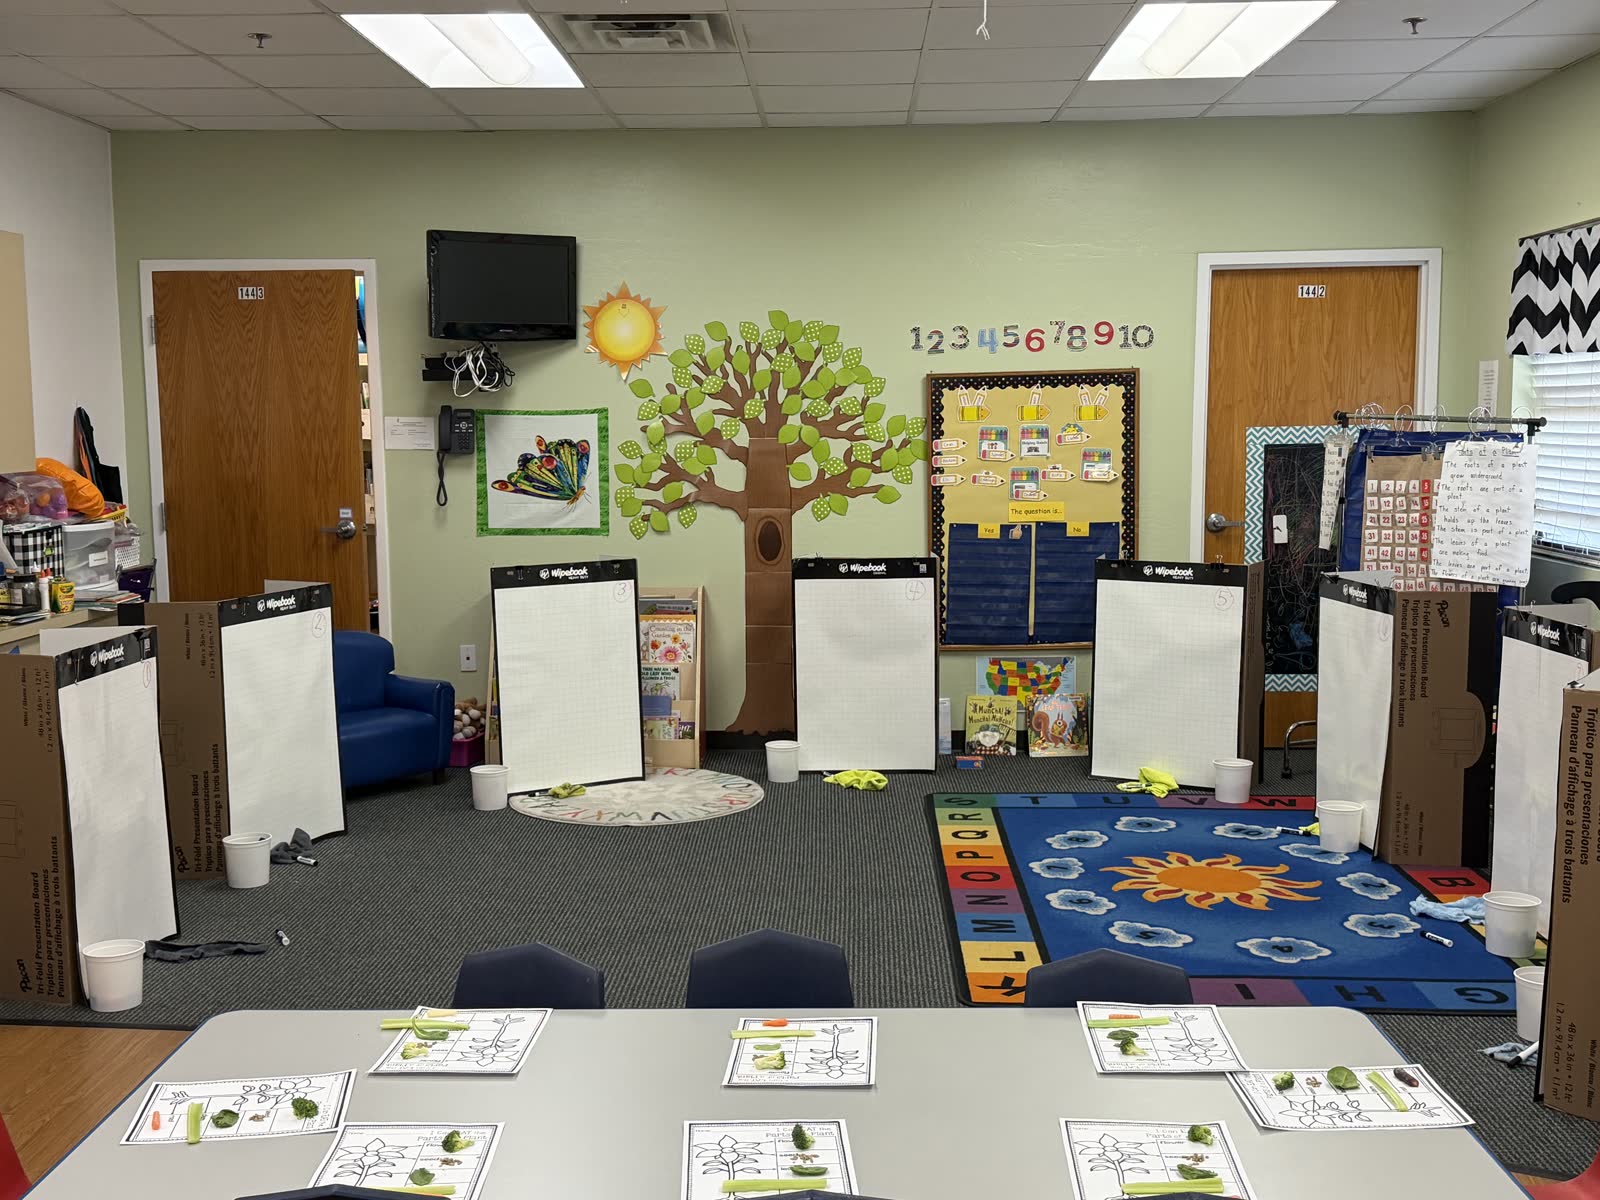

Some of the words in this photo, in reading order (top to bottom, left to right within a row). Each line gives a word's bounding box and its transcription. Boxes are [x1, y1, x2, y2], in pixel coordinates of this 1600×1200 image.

[240, 288, 263, 298] 1443
[1300, 286, 1325, 297] 1442
[910, 326, 924, 350] 1
[927, 330, 945, 354] 2
[950, 325, 970, 350] 3
[978, 328, 998, 353] 4
[1003, 325, 1020, 348] 5
[1025, 328, 1045, 352] 6
[1050, 320, 1066, 344] 7
[1067, 325, 1088, 352] 8
[1094, 321, 1114, 345] 9
[1118, 325, 1155, 349] 10
[1488, 460, 1494, 468] of
[1512, 461, 1528, 470] plant
[1450, 473, 1464, 483] grow
[1386, 483, 1390, 491] 2
[1441, 483, 1451, 491] The
[1457, 483, 1473, 491] roots
[1493, 486, 1505, 494] part
[1384, 500, 1390, 508] 12
[1495, 506, 1511, 514] plant
[1024, 508, 1050, 516] question
[1382, 516, 1390, 524] 22
[1398, 516, 1405, 524] 23
[1411, 516, 1418, 524] 24
[1444, 515, 1458, 523] holds
[1471, 538, 1479, 546] of
[551, 566, 588, 580] Wipebook
[850, 562, 887, 574] Wipebook
[1154, 565, 1194, 577] Wipebook
[1408, 566, 1414, 574] 54
[1407, 582, 1414, 590] 64
[266, 595, 296, 610] Wipebook
[1400, 599, 1410, 630] Panneau
[1422, 600, 1431, 626] Tri-Fold
[1436, 600, 1450, 628] Pacon
[650, 624, 676, 632] Counting
[684, 624, 692, 632] the
[1538, 624, 1560, 640] Wipebook
[1410, 628, 1418, 644] para
[99, 644, 124, 664] Wipebook
[1421, 628, 1430, 674] Presentation
[1410, 646, 1418, 701] presentaciones
[1420, 676, 1429, 698] Board
[1398, 697, 1406, 728] battants
[1568, 705, 1582, 754] Panneau
[1582, 752, 1594, 777] para
[1564, 756, 1580, 816] d'affichage
[944, 797, 978, 806] S
[1020, 796, 1048, 804] T
[1102, 796, 1131, 804] U
[1180, 798, 1208, 806] V
[1251, 798, 1296, 806] W
[192, 799, 200, 842] Presentation
[948, 812, 982, 820] R
[1580, 781, 1594, 866] presentaciones
[952, 830, 989, 840] Q
[1234, 827, 1263, 836] 10
[1564, 830, 1576, 855] trois
[51, 836, 59, 874] battants
[175, 846, 190, 873] Pacon
[956, 850, 994, 859] P
[960, 871, 1000, 882] O
[1428, 878, 1476, 887] B
[1562, 858, 1576, 904] battants
[31, 872, 40, 899] Board
[52, 876, 60, 898] trois
[42, 869, 53, 938] presentaciones
[966, 894, 1008, 906] N
[33, 902, 43, 960] Presentation
[971, 919, 1016, 933] M
[1136, 931, 1160, 940] 5
[46, 940, 54, 960] para
[980, 950, 1026, 962] L
[17, 958, 32, 993] Pacon
[34, 962, 44, 994] Tri-Fold
[56, 960, 65, 998] Panneau
[976, 975, 1026, 996] K
[1334, 985, 1386, 1002] H
[1454, 987, 1510, 1004] G
[1556, 1002, 1565, 1014] 1.2
[1556, 1016, 1562, 1024] m
[1568, 1022, 1576, 1034] 48
[1554, 1034, 1564, 1050] 91.4
[1567, 1034, 1575, 1042] in
[1554, 1052, 1560, 1064] cm
[1566, 1052, 1575, 1062] 36
[1564, 1082, 1574, 1092] 12
